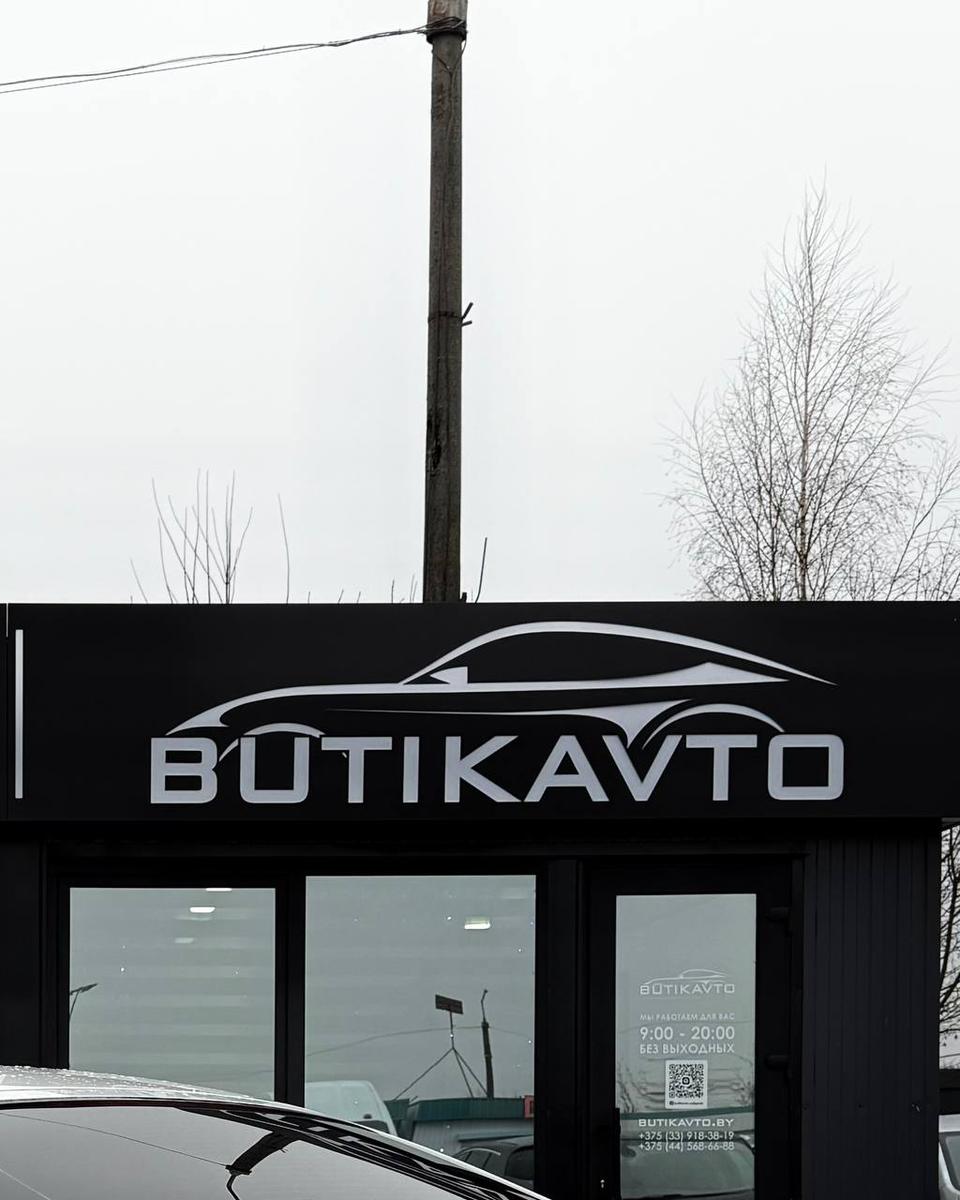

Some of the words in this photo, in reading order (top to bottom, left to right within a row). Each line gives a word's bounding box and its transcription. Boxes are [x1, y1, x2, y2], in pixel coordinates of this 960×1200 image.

[149, 733, 845, 805] BUTIKAVTO
[640, 983, 735, 995] BUTIKAVTO
[700, 1013, 717, 1021] ДЛЯ
[640, 1026, 673, 1040] 9:00
[691, 1026, 735, 1040] 20:00
[640, 1044, 659, 1054] БЕЗ
[662, 1044, 735, 1054] ВЫХОДНЫХ
[639, 1118, 734, 1127] BUTIKAVTO.BY
[639, 1132, 662, 1140] +375
[665, 1131, 683, 1142] (33)
[687, 1131, 734, 1140] 918-38-19
[639, 1142, 662, 1150] +375
[665, 1142, 683, 1152] (44)
[687, 1142, 735, 1151] 568-66-88
